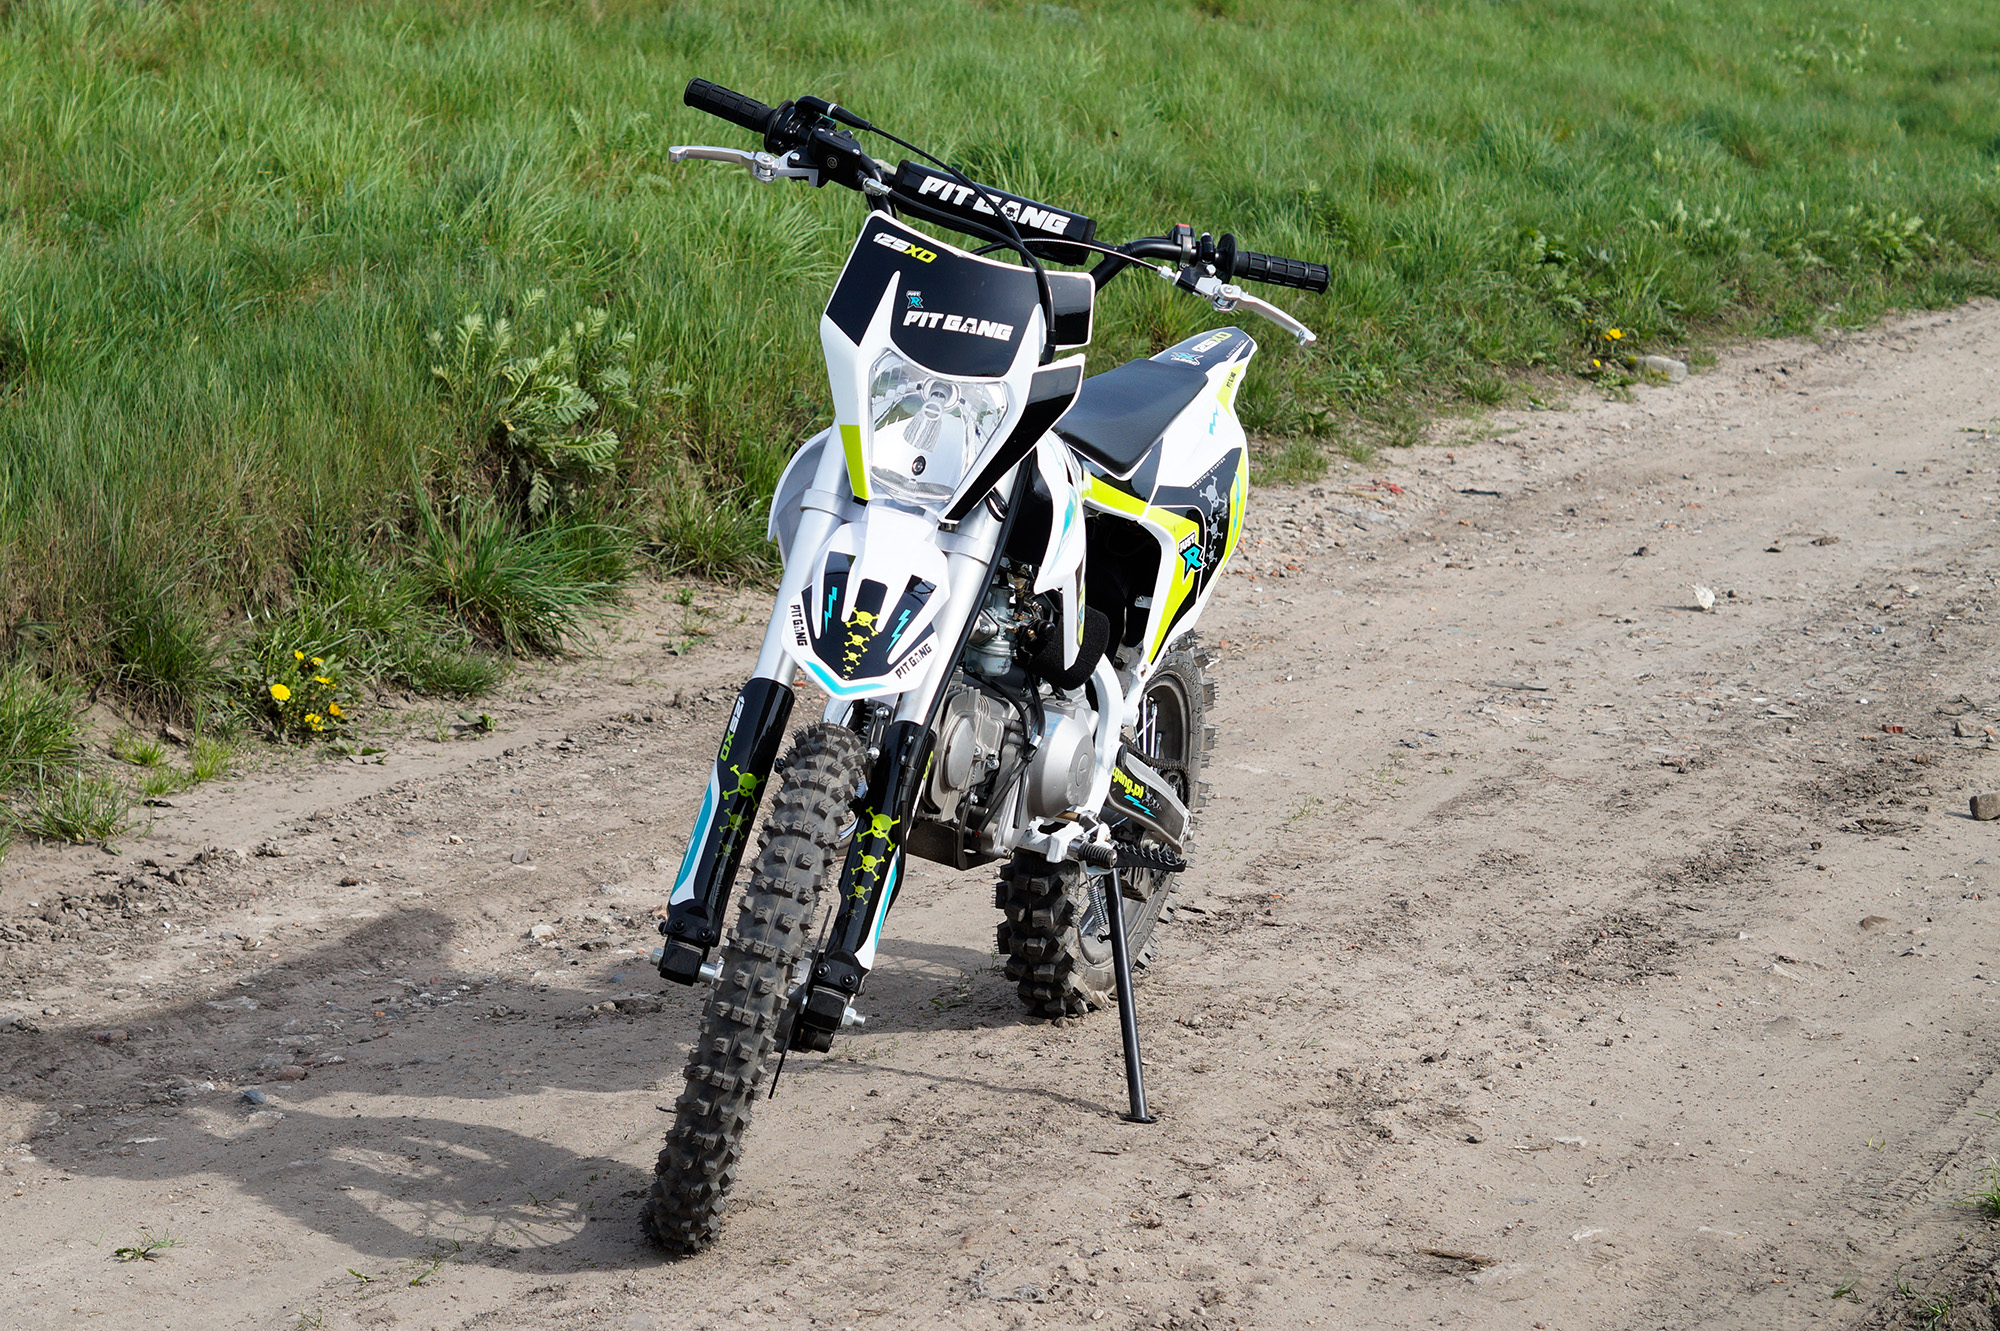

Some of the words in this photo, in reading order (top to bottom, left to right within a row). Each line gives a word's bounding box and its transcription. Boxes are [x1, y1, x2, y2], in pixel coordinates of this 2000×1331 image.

[917, 175, 976, 206] PIT
[972, 193, 1071, 236] GANG
[872, 232, 938, 264] 125XD
[902, 310, 945, 329] PIT
[942, 314, 1014, 342] GANG
[1179, 533, 1196, 553] JUST
[790, 604, 801, 618] PIT
[792, 618, 808, 647] GANG
[895, 662, 910, 680] PIT
[909, 643, 932, 667] GANG
[720, 695, 746, 762] 125XD
